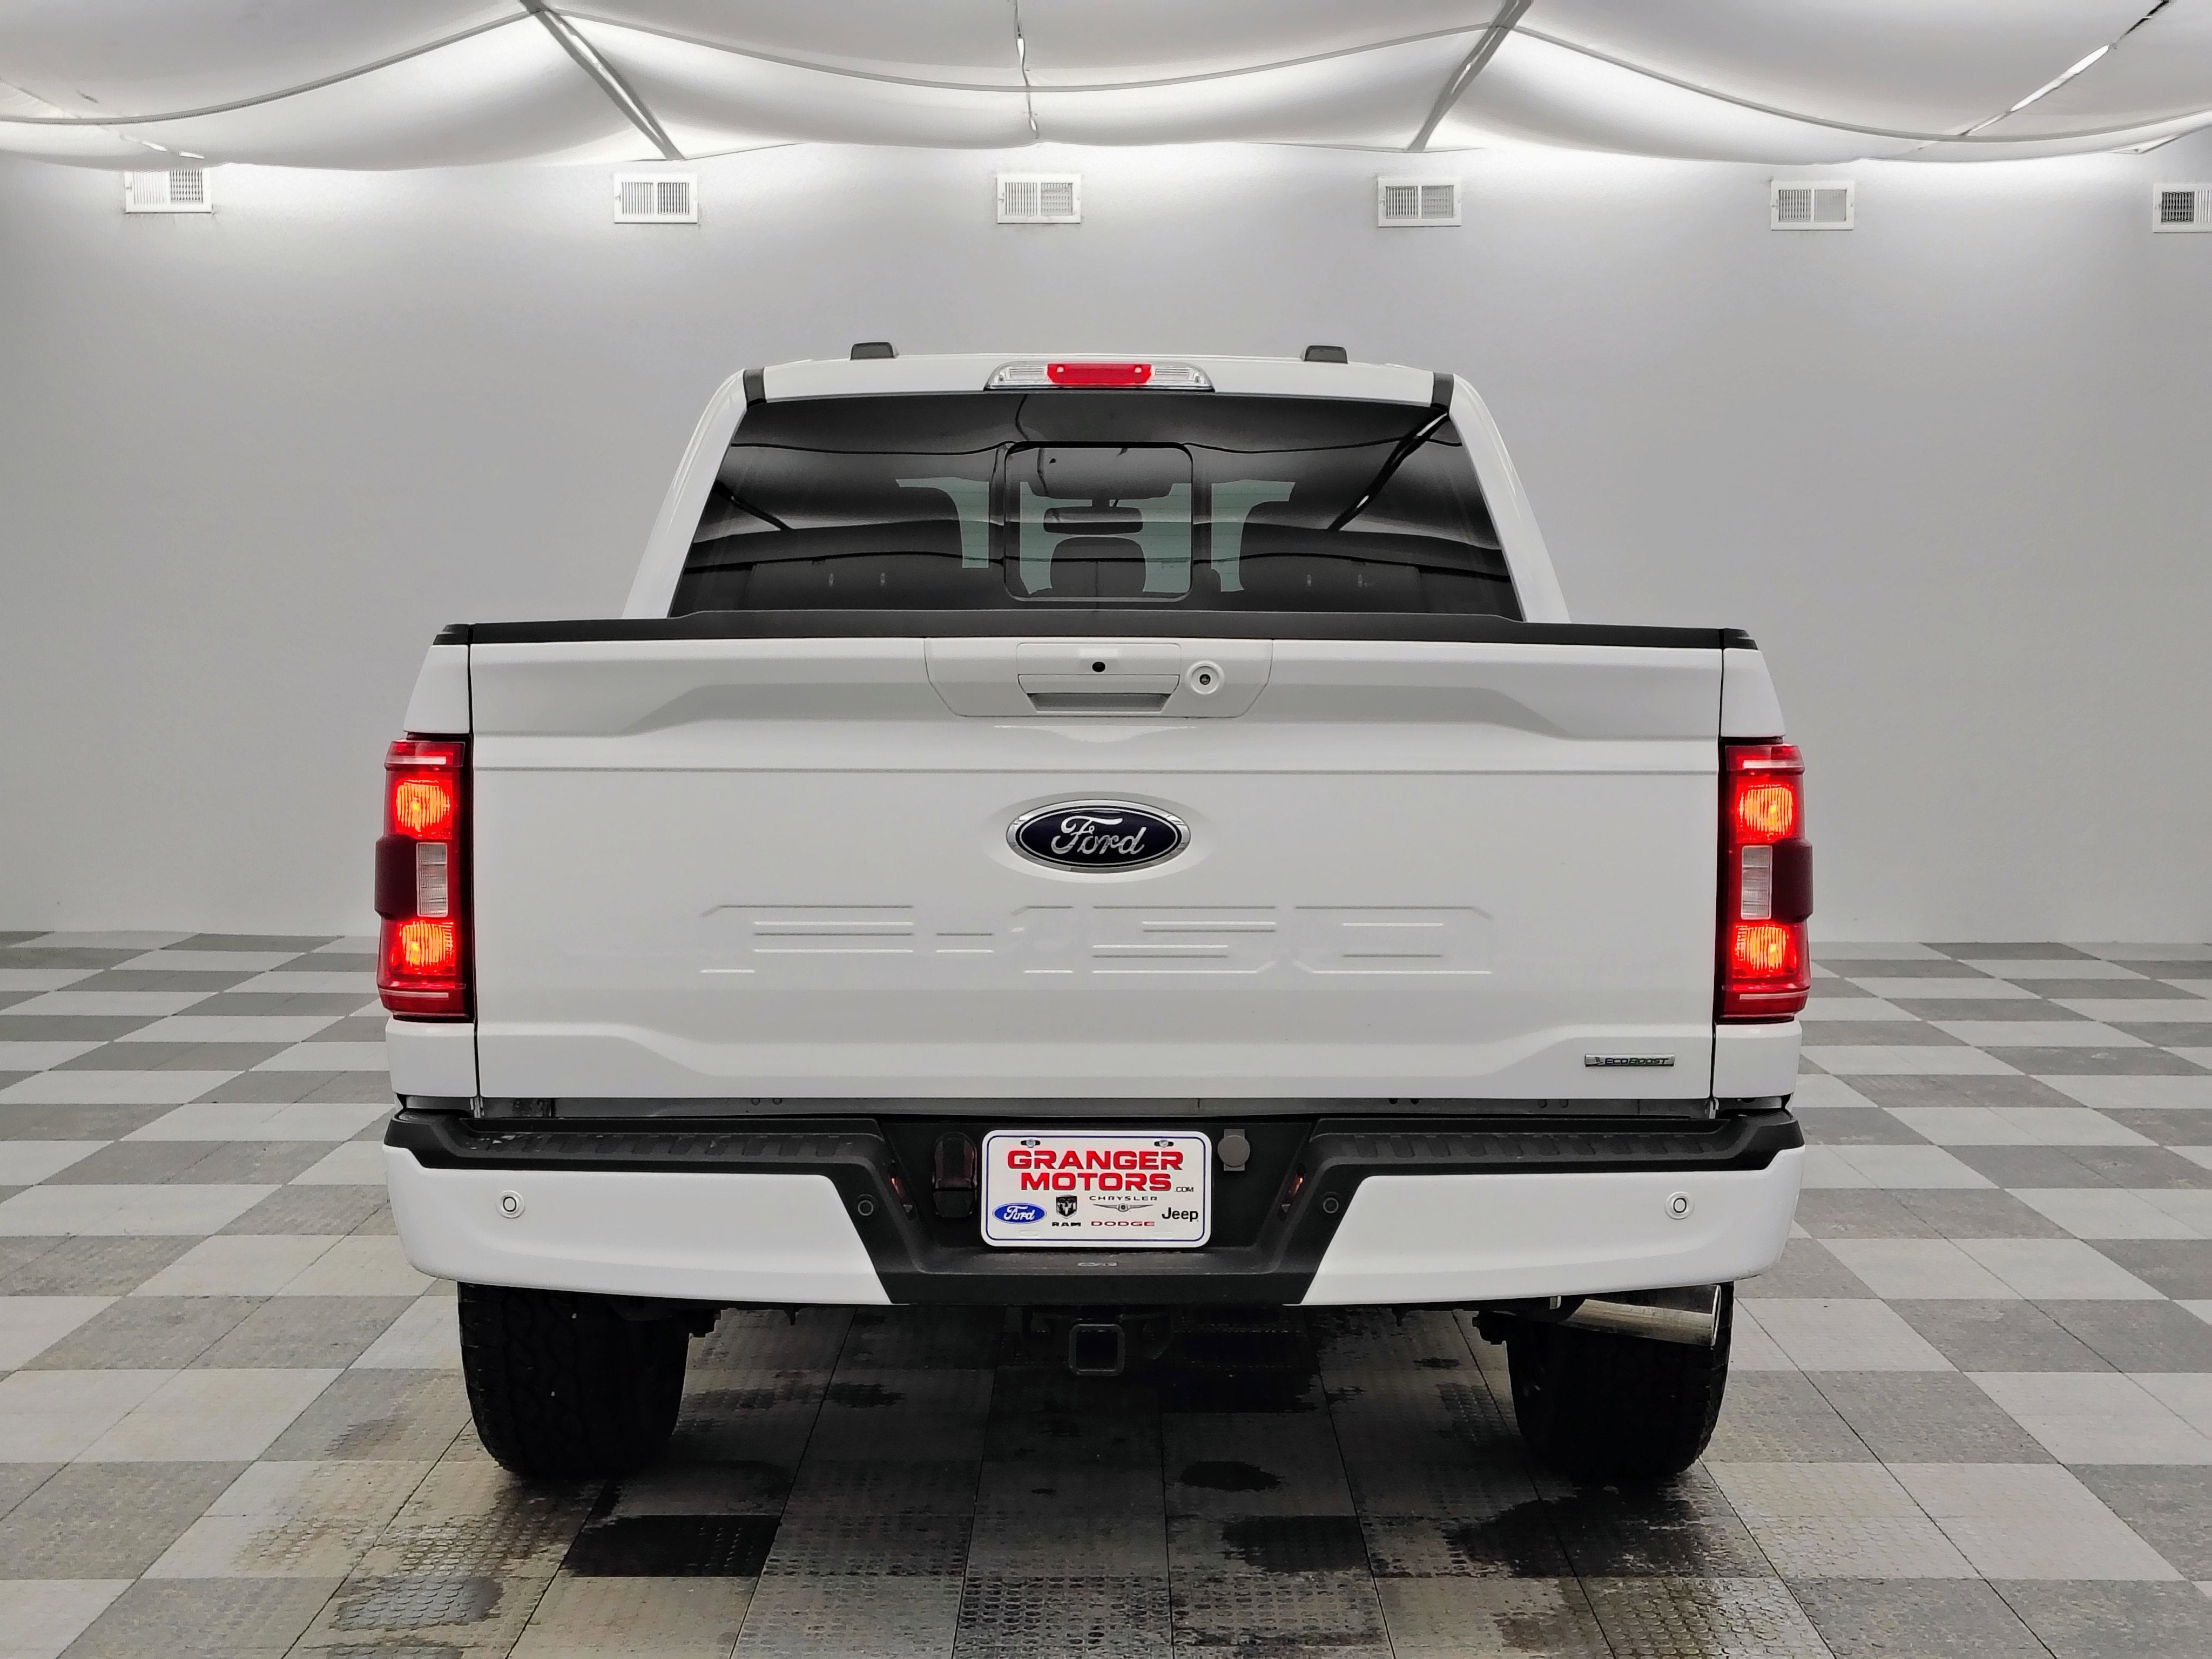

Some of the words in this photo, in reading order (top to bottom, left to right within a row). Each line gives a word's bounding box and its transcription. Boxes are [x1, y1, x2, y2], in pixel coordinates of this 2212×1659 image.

[1050, 815, 1147, 855] Ford
[1007, 1150, 1184, 1170] GRANGER
[1021, 1172, 1172, 1191] MOTORS
[1003, 1205, 1036, 1222] Ford
[1162, 1207, 1199, 1222] Jeep
